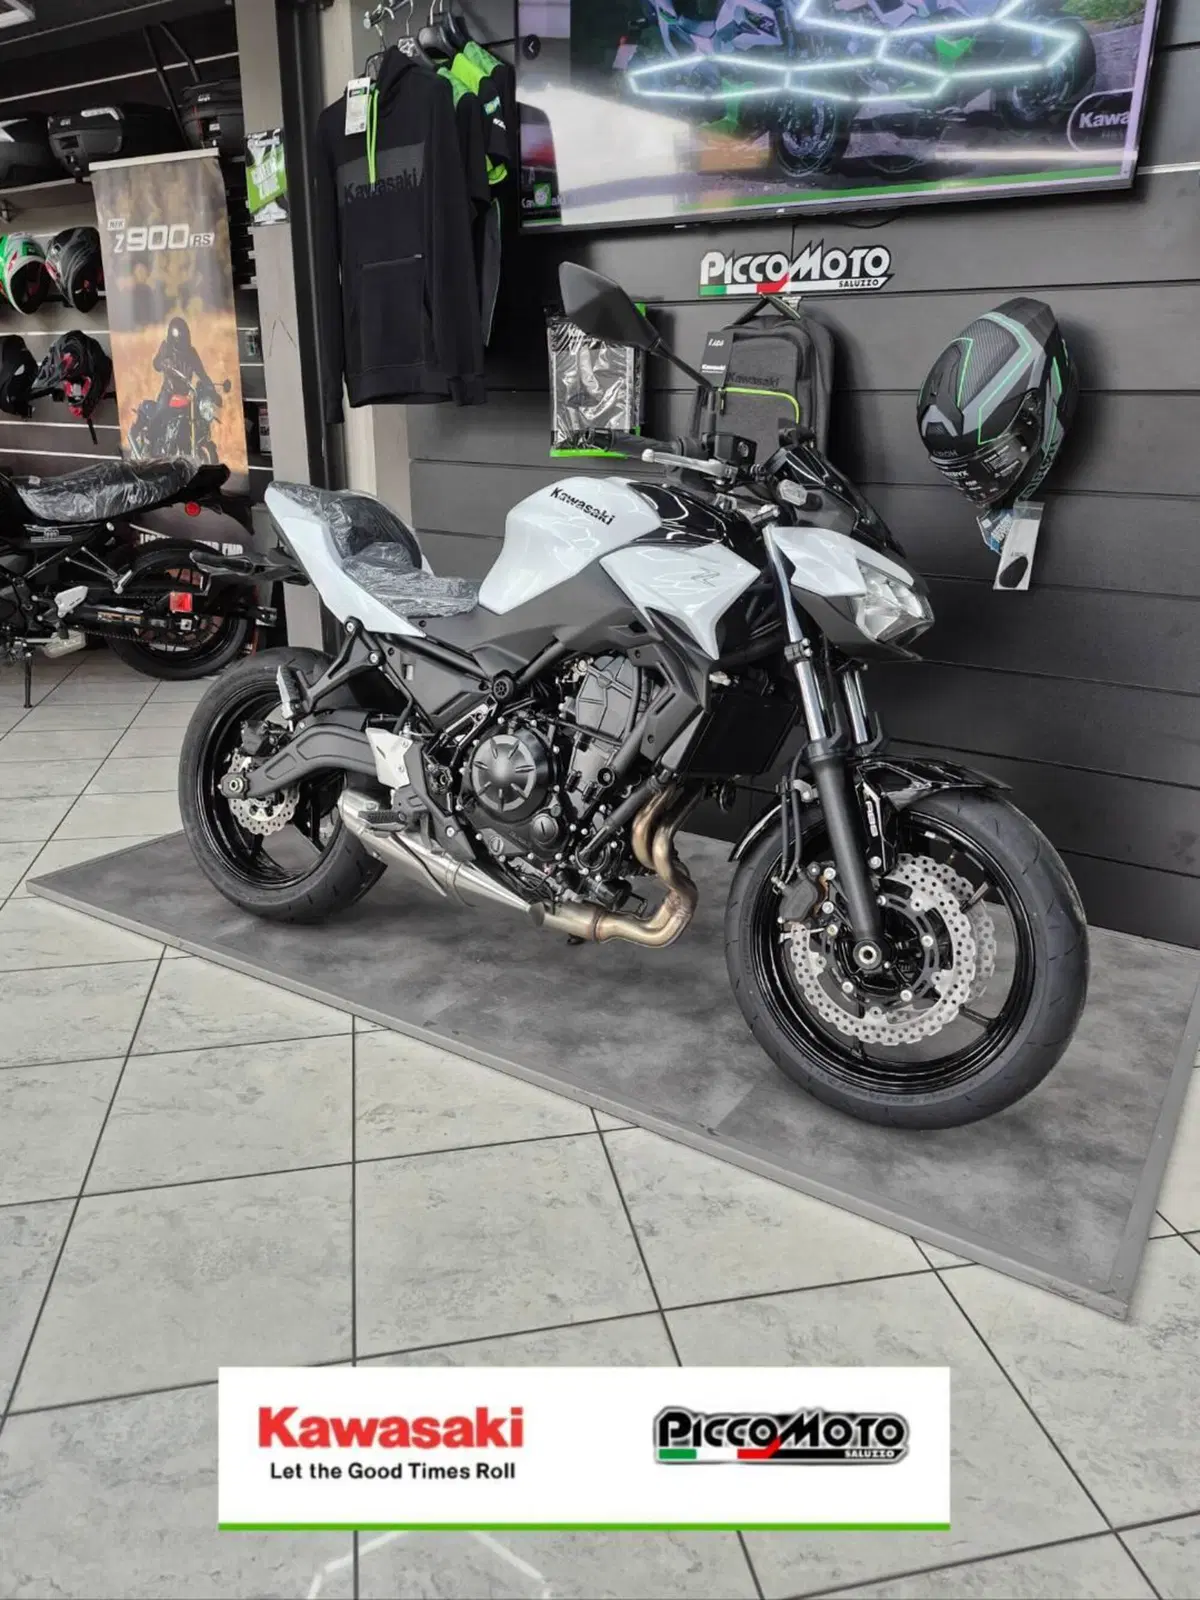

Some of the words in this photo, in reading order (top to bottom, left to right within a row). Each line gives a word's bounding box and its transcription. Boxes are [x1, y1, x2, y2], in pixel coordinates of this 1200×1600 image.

[1079, 111, 1131, 128] Kawa
[838, 278, 880, 288] SALUZZO
[551, 486, 616, 526] Kawasaki
[865, 800, 879, 837] ABS
